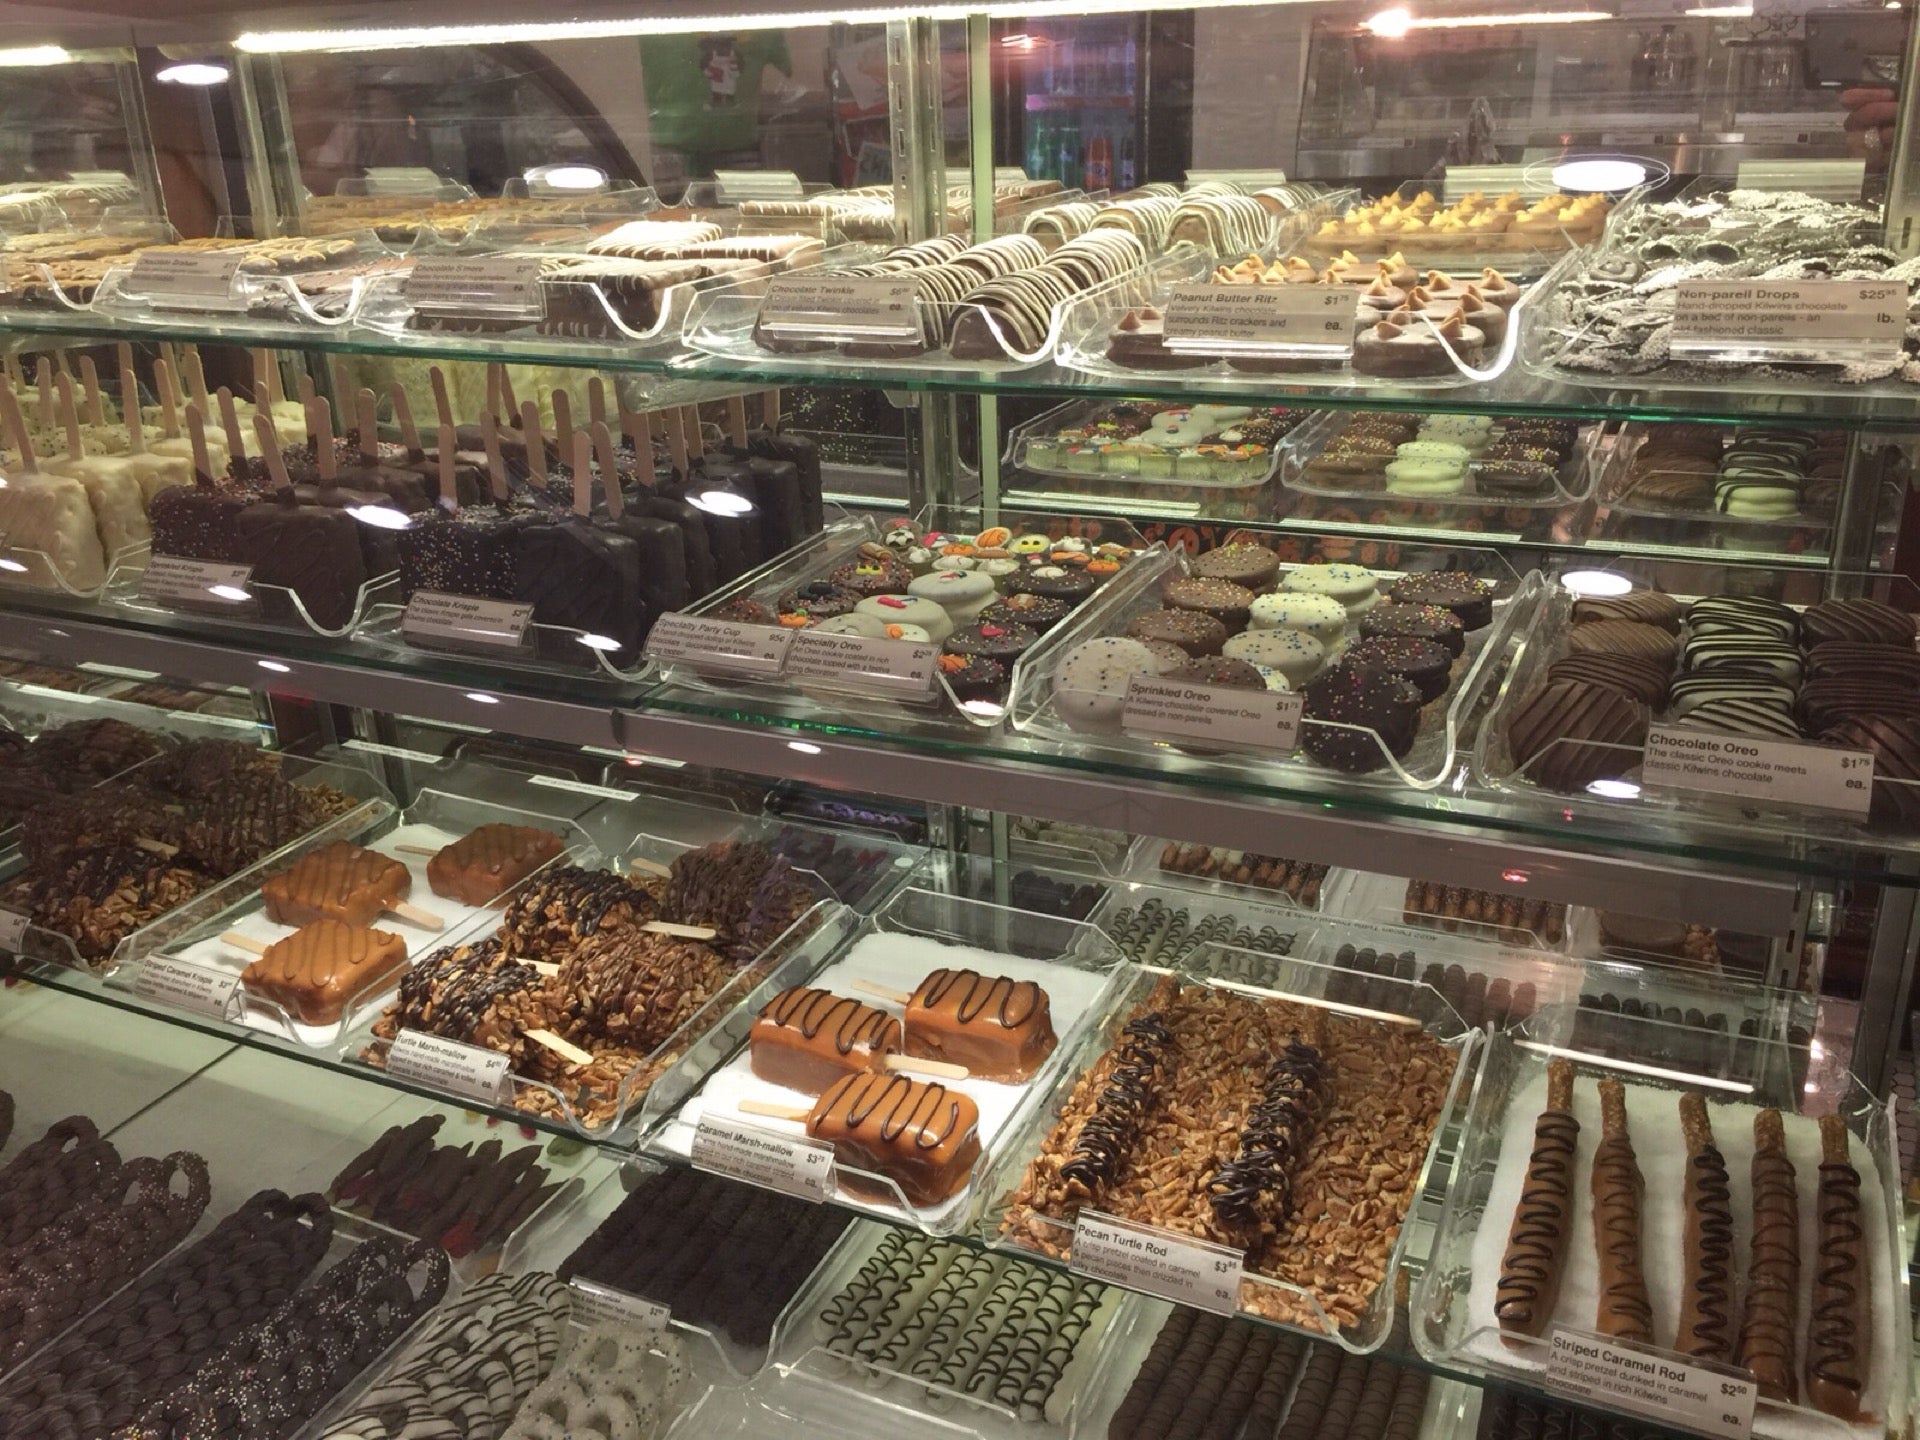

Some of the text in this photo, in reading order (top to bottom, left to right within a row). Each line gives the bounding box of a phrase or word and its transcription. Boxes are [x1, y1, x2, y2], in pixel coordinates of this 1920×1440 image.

[772, 285, 855, 295] Chocolate Twinkie
[1679, 290, 1800, 301] Non-pareil Drops
[1174, 293, 1278, 304] Peanut Butter Ritz
[1677, 302, 1848, 313] Hand-dropped Kilwins chocolate
[1167, 315, 1287, 328] surrounds Ritz crackers and
[1324, 320, 1343, 331] ea.
[1877, 313, 1896, 324] lb.
[1748, 325, 1784, 335] classic
[413, 596, 480, 612] Chocolate Krispie
[659, 619, 698, 631] Specialty
[700, 624, 721, 635] Party
[723, 627, 741, 637] Cup
[797, 635, 863, 651] Specialty Oreo
[764, 652, 776, 660] ea.
[790, 655, 822, 665] chocolate
[847, 662, 861, 671] with
[804, 647, 821, 656] Oreo
[821, 650, 844, 659] cookie
[845, 653, 868, 662] coated
[877, 656, 890, 664] rich
[910, 671, 924, 679] ea.
[1131, 683, 1211, 702] Sprinkled Oreo
[1125, 706, 1157, 717] dressed
[1159, 710, 1166, 718] in
[1205, 706, 1238, 717] covered
[1240, 710, 1261, 720] Oreo
[1277, 721, 1294, 731] ea.
[1650, 733, 1759, 758] Chocolate Oreo
[1648, 748, 1807, 776] The classic Oreo cookie meets
[1645, 760, 1774, 784] classic Kilwins chocolate
[1845, 779, 1868, 791] ea.
[167, 966, 192, 977] Caramel
[397, 1034, 417, 1047] Turtle
[418, 1041, 467, 1061] Marsh-mallow
[697, 1123, 733, 1140] Caramel
[734, 1132, 794, 1157] Marsh-mallow
[1078, 1224, 1168, 1257] Pecan Turtle Rod
[1075, 1238, 1200, 1280] A crisp pretzel coated in caramel
[1080, 1252, 1105, 1266] pecan
[1106, 1257, 1132, 1273] pieces
[1133, 1264, 1151, 1277] then
[1152, 1270, 1184, 1287] drizzled
[1185, 1279, 1194, 1289] in
[1090, 1265, 1128, 1282] chocolate
[1215, 1288, 1232, 1301] ea.
[1553, 1336, 1687, 1383] Striped Caramel Rod
[1549, 1364, 1668, 1406] and striped in rich Kilwins
[1550, 1352, 1708, 1403] A crisp pretzel dunked in caramel
[1547, 1376, 1592, 1397] chocolate
[1722, 1412, 1743, 1427] ea.
